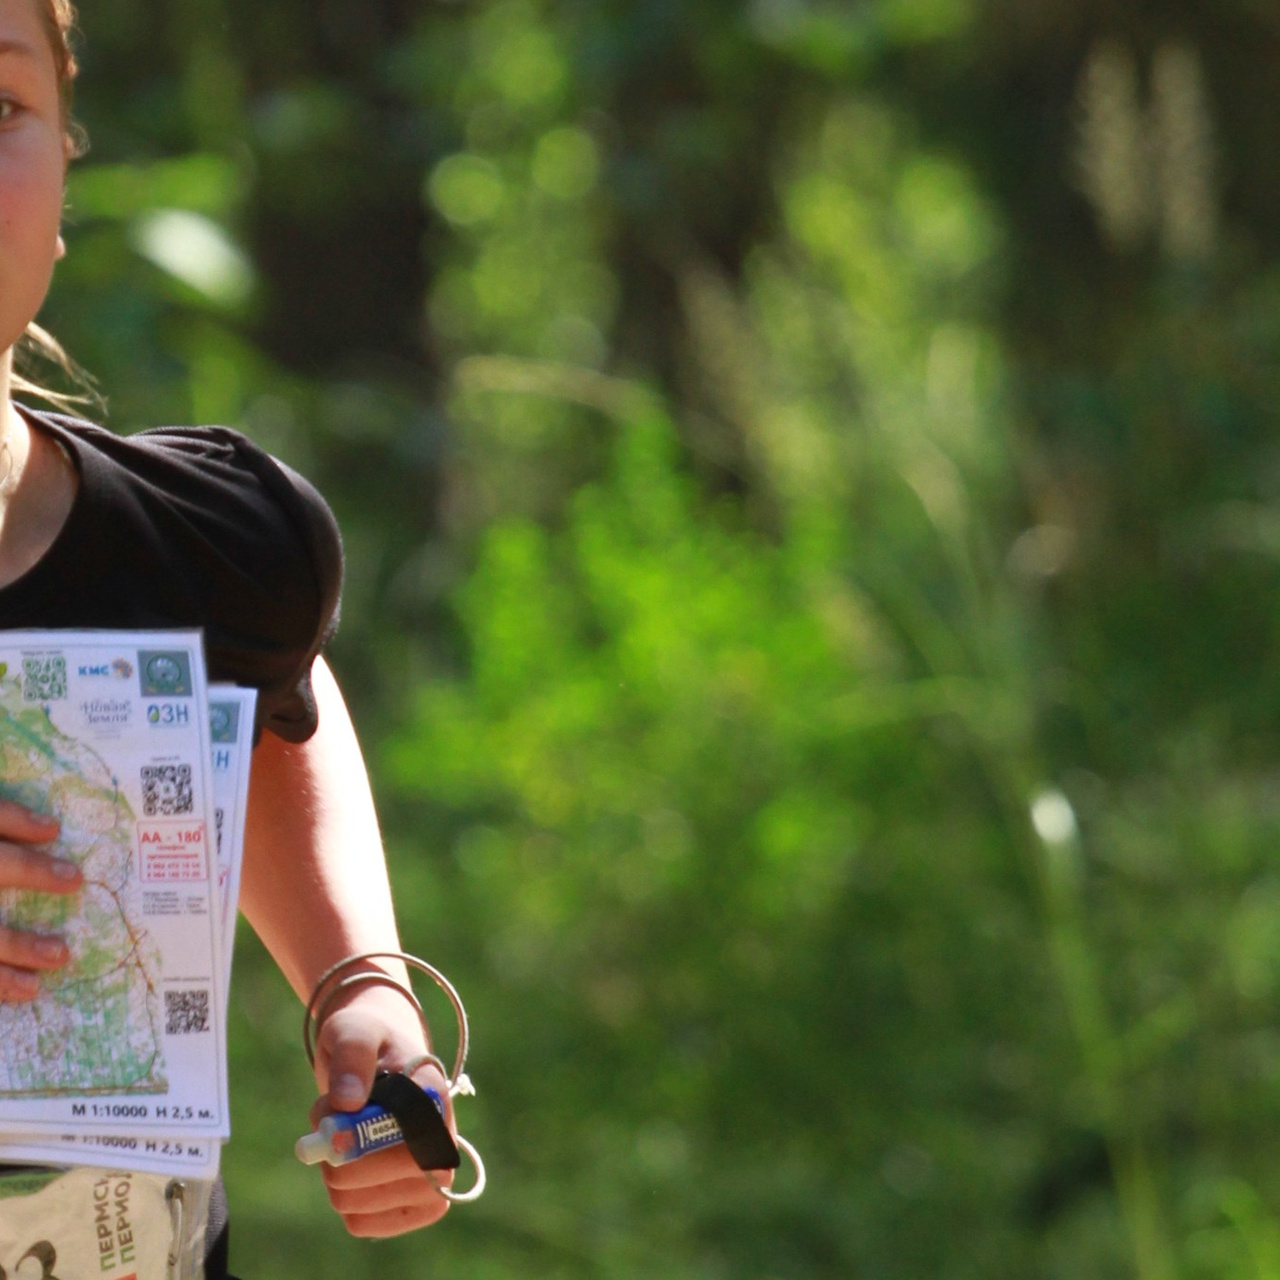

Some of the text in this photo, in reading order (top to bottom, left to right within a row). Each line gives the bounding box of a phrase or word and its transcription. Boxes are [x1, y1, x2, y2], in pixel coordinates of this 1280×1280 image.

[92, 1105, 148, 1117] 1:10000
[172, 1107, 193, 1120] 2,5
[162, 1143, 183, 1155] 2,5
